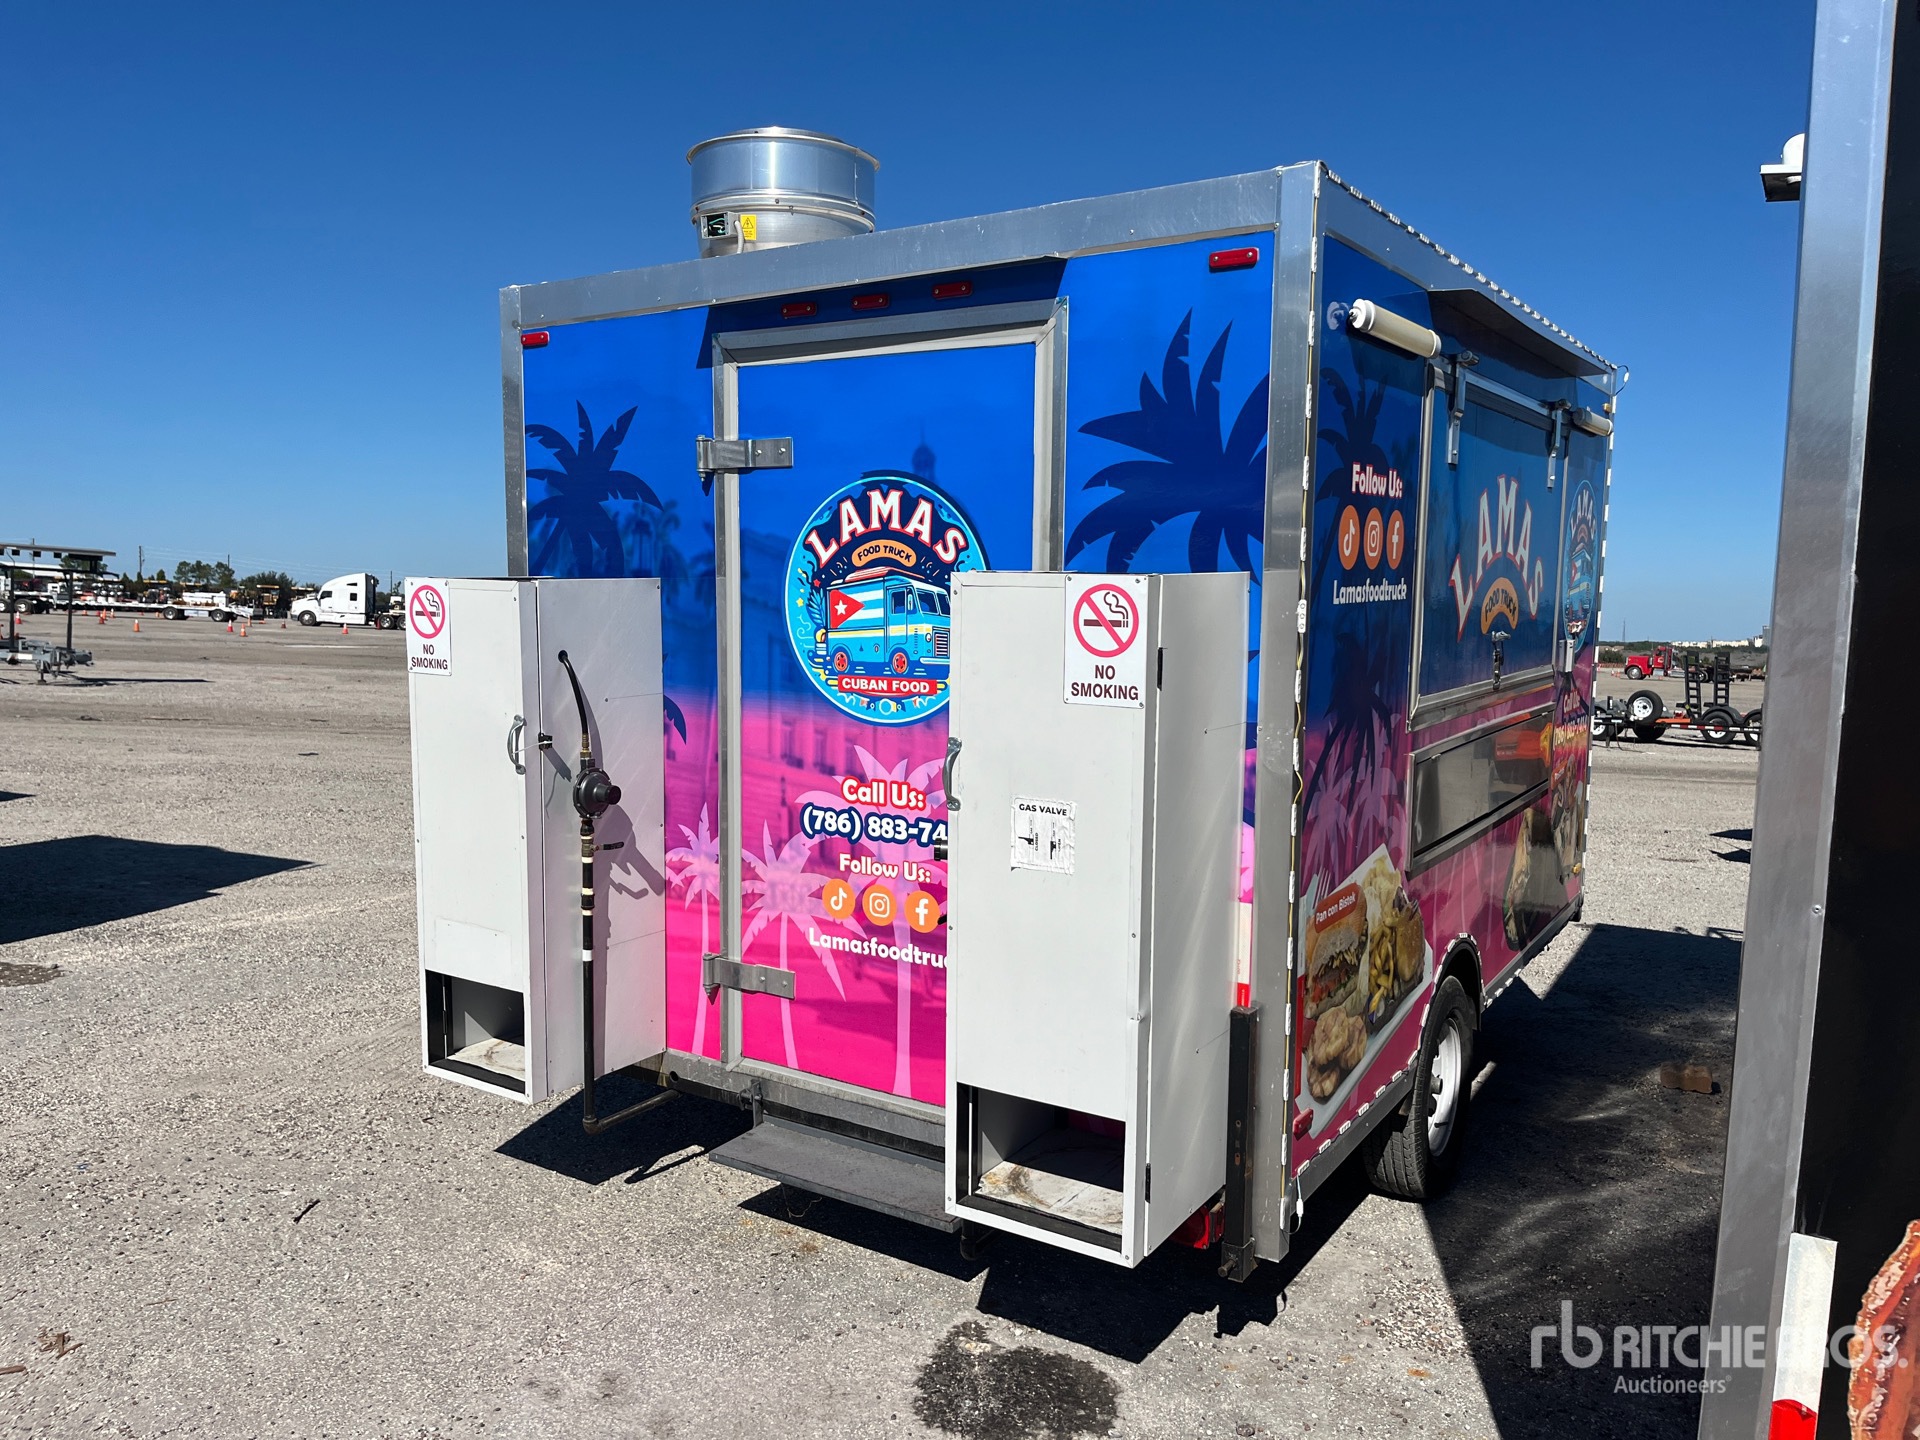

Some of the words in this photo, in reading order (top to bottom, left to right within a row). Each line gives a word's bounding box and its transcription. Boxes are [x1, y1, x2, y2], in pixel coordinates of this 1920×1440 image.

[1351, 462, 1387, 496] Follow
[1388, 469, 1403, 498] Us:
[804, 488, 967, 568] LAMAS
[1570, 488, 1597, 541] LAMAS
[856, 544, 881, 562] FOOD
[883, 544, 913, 563] TRUCK
[1449, 474, 1543, 643] LAMAS
[1332, 577, 1407, 605] Lamasfoodtruck
[1484, 587, 1500, 623] FOOD
[1501, 588, 1517, 621] TRUCK
[411, 656, 449, 670] SMOKING
[422, 643, 435, 655] NO
[841, 677, 888, 692] CUBAN
[892, 680, 930, 694] FOOD
[1094, 664, 1116, 680] NO
[1070, 682, 1140, 701] SMOKING
[842, 778, 886, 805] Call
[890, 782, 926, 809] Us:
[802, 806, 862, 840] (786)
[1018, 803, 1037, 812] GAS
[1039, 805, 1068, 816] VALVE
[839, 853, 899, 879] Follow
[903, 862, 931, 883] Us:
[1315, 911, 1328, 925] Pan
[1328, 904, 1339, 917] con
[1338, 891, 1356, 911] Bistek
